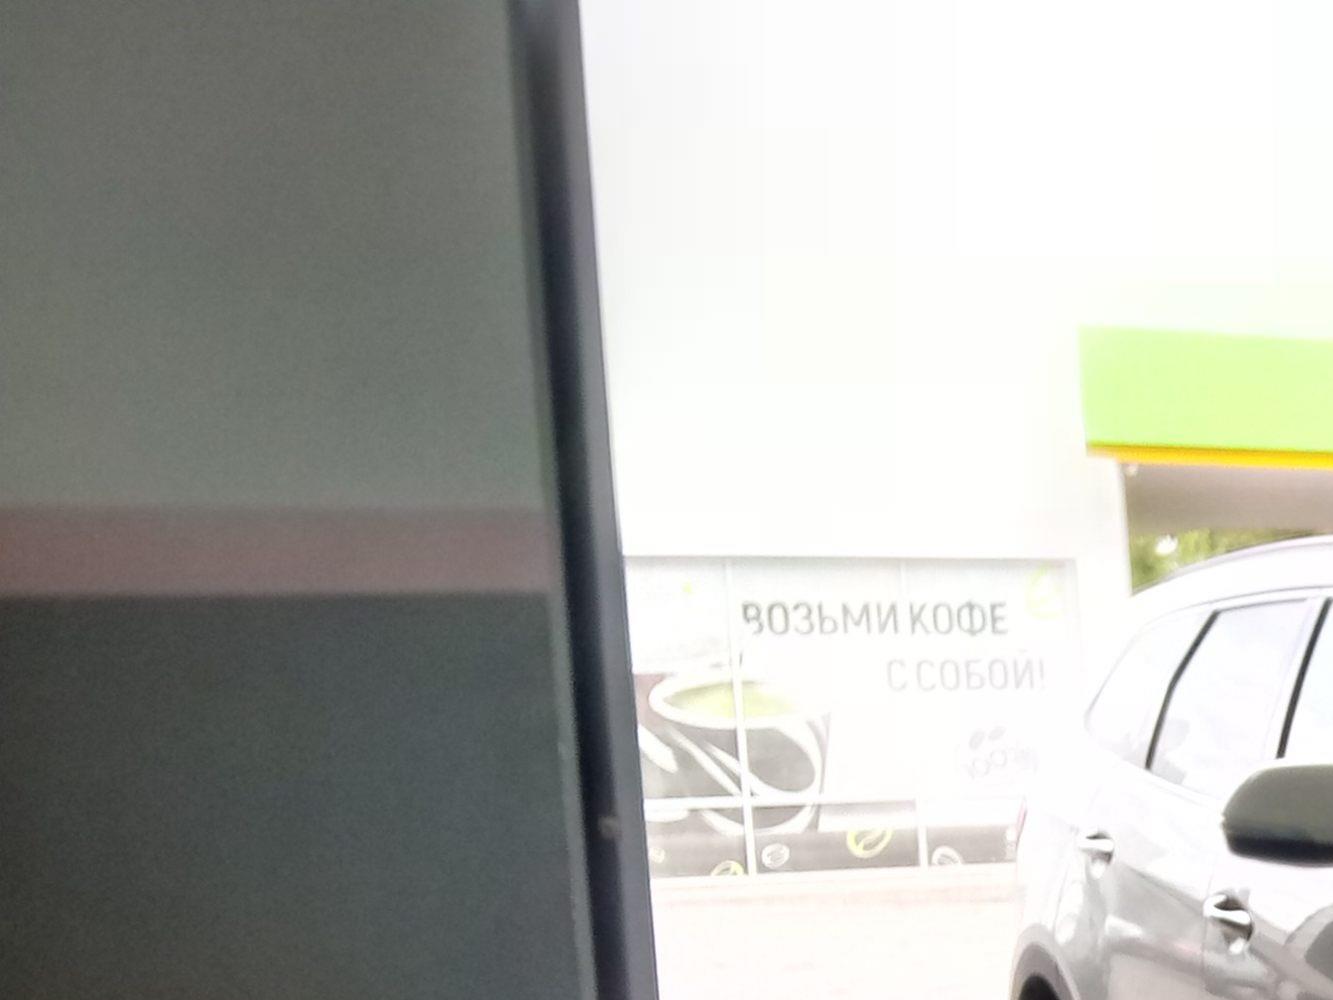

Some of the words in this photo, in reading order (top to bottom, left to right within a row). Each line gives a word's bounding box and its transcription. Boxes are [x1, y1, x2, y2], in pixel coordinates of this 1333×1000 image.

[740, 600, 900, 636] ВОЗЬМИ
[909, 599, 1009, 637] КОФЕ
[886, 658, 908, 692] С
[915, 647, 1047, 692] СОБОЙ!
